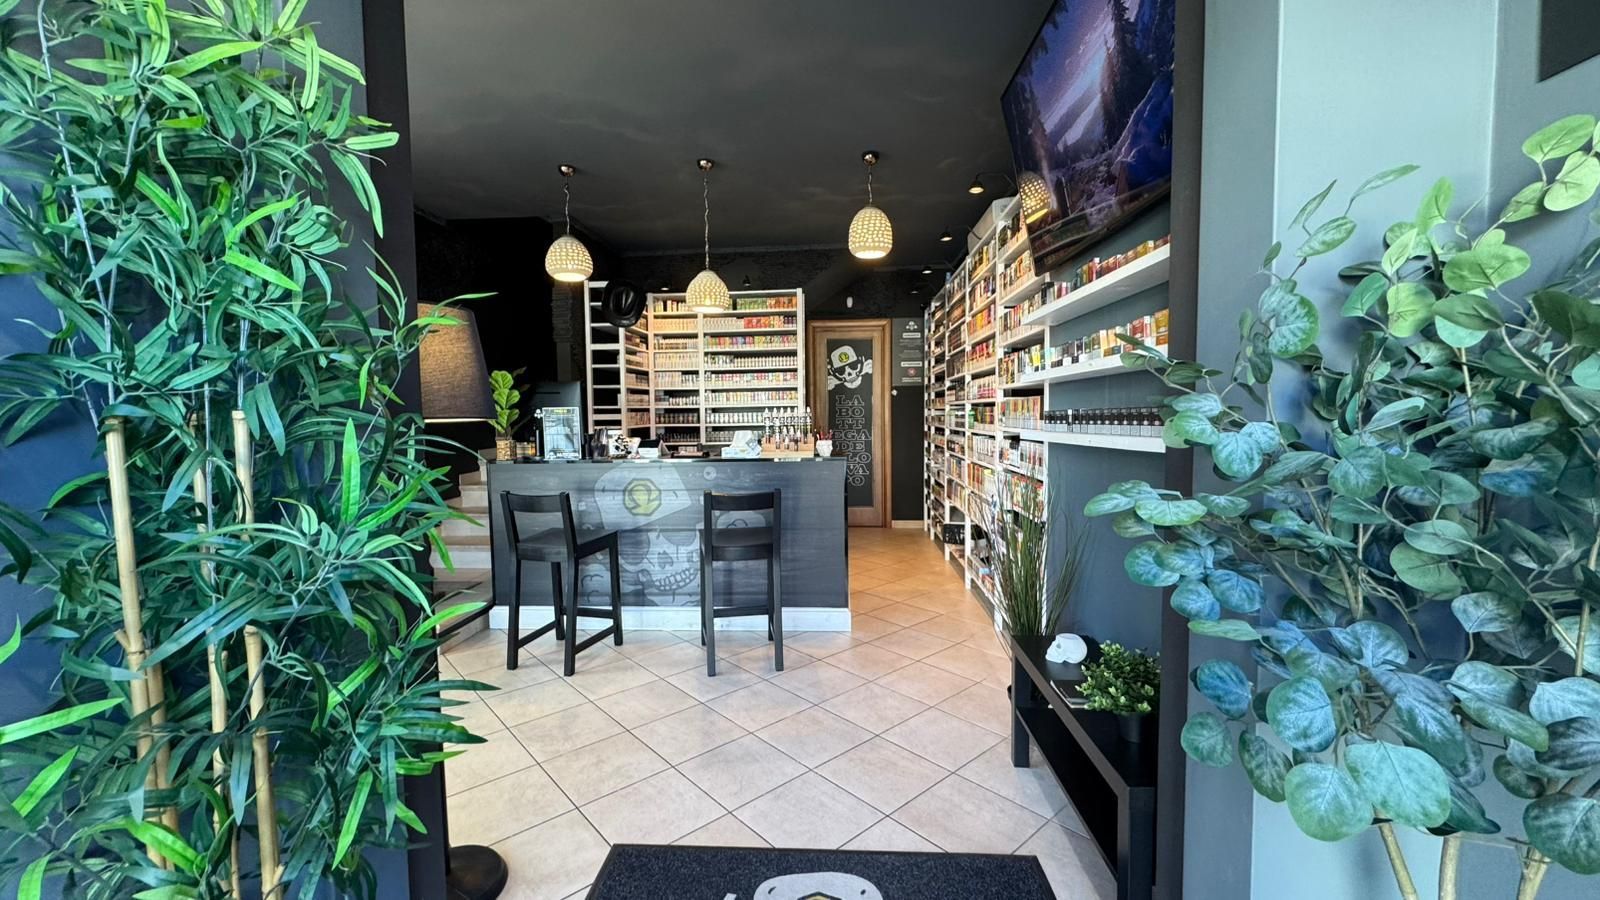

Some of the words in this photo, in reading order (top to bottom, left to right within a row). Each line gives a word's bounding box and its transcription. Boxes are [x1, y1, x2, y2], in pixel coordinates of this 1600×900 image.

[836, 395, 864, 406] LA
[836, 407, 864, 417] BO
[836, 418, 865, 429] TT
[833, 429, 872, 440] EGA
[836, 441, 865, 452] DE
[848, 452, 871, 463] LO
[847, 463, 869, 475] VA
